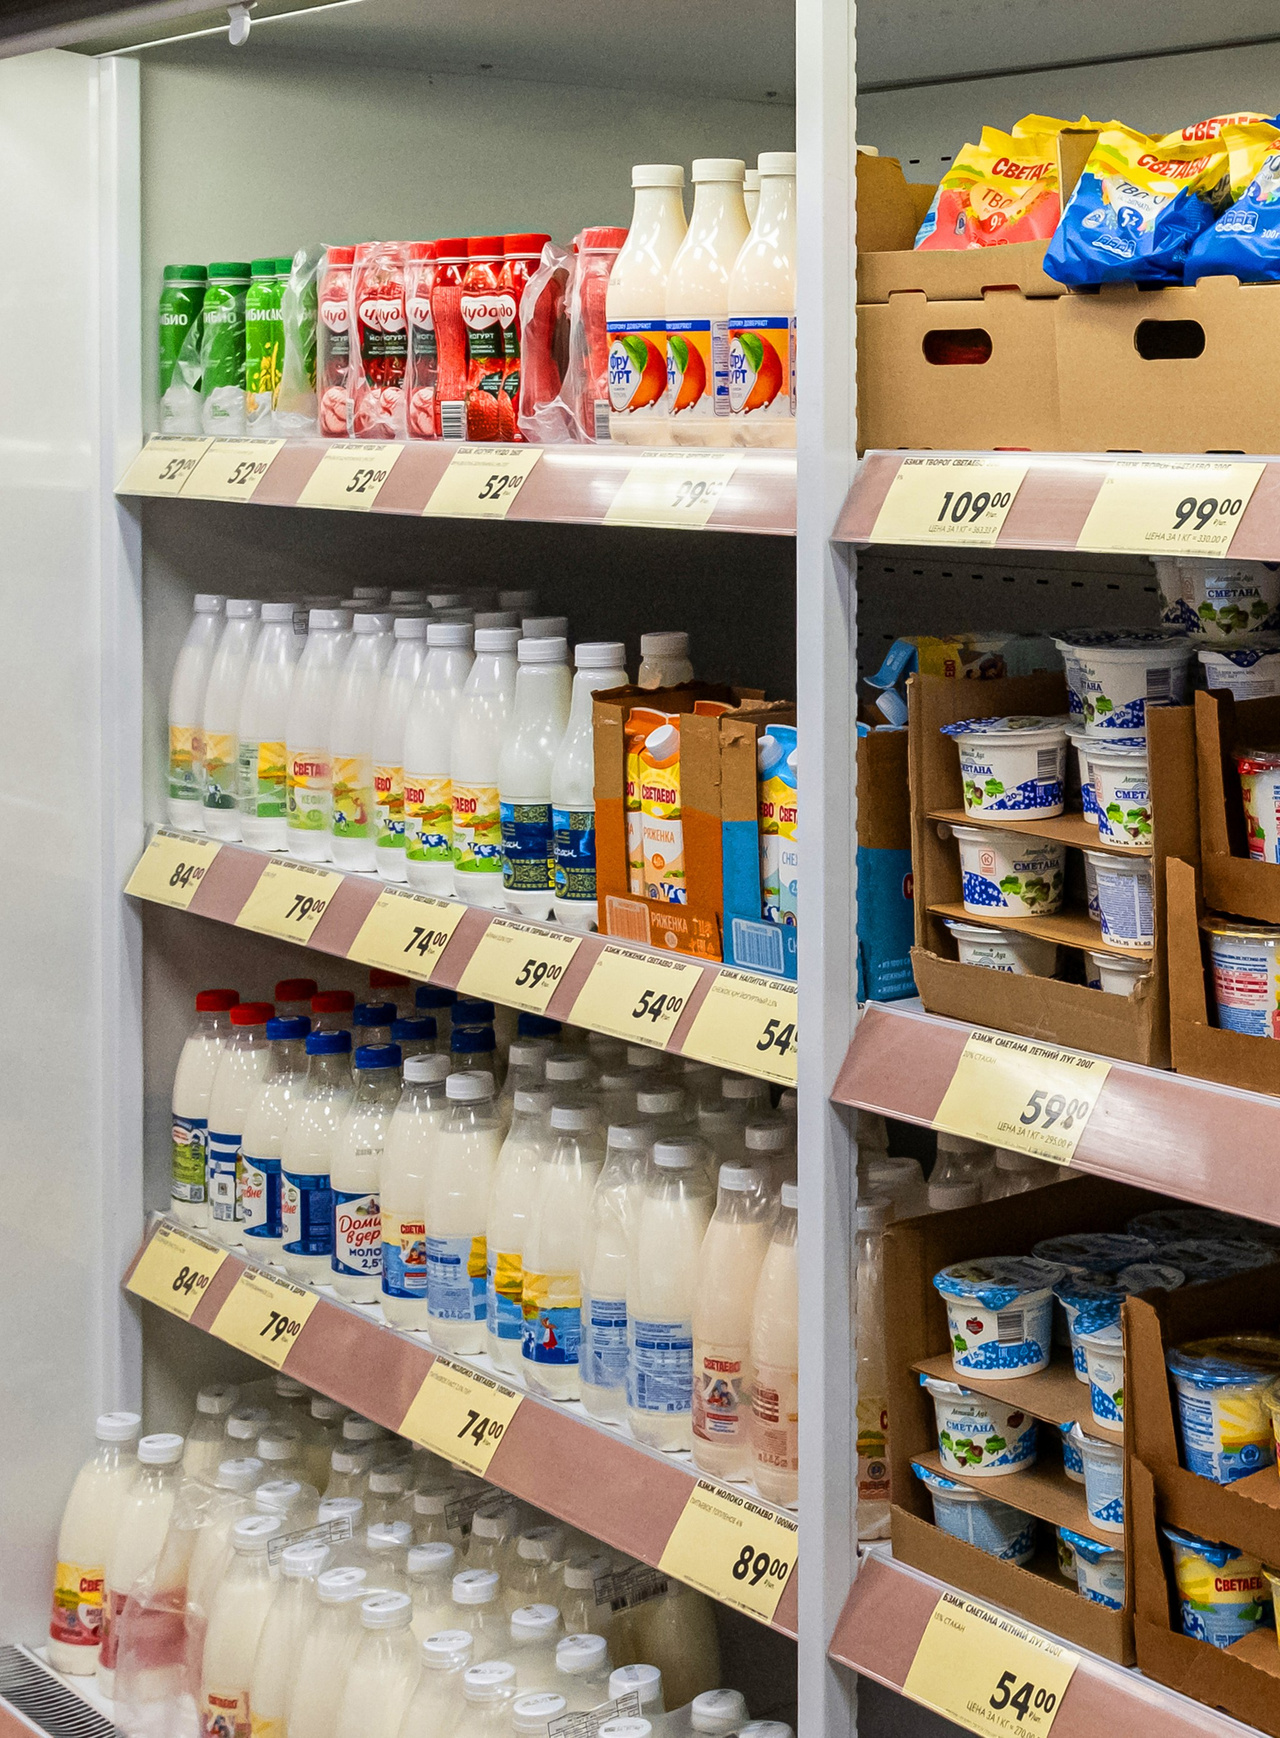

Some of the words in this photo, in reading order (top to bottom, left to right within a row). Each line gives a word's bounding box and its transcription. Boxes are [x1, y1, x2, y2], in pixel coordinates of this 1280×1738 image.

[929, 525, 946, 533] ЦЕНА
[1145, 532, 1165, 541] ЦЕНА
[1166, 533, 1176, 541] ЗА
[1207, 588, 1260, 598] СМЕТАНА
[641, 785, 677, 804] СВЕТАЕВО
[779, 806, 797, 822] СВЕТ
[643, 827, 675, 844] РЯЖЕНКА
[1014, 860, 1060, 872] СМЕТАНА
[651, 912, 688, 933] РЯЖЕНКА
[971, 1032, 994, 1044] БЗМЖ
[995, 1038, 1028, 1053] СМЕТАНА
[1029, 1046, 1060, 1060] ЛЕТНИЙ
[1059, 1053, 1075, 1064] ЛУГ
[997, 1121, 1016, 1133] ЦЕНА
[1016, 1126, 1027, 1136] ЗА
[1030, 1130, 1041, 1140] КГ
[355, 1229, 381, 1246] дер
[946, 1420, 995, 1433] СМЕТАНА
[715, 1487, 744, 1507] МОЛОКО
[743, 1501, 774, 1520] СВЕТАЕВО
[943, 1592, 965, 1610] БЗМЖ
[965, 1604, 998, 1627] СМЕТАНА
[998, 1618, 1030, 1641] ЛЕТНИЙ
[1028, 1633, 1044, 1649] ЛУГ
[943, 1616, 966, 1633] СТАКАН
[966, 1700, 986, 1717] ЦЕНА
[985, 1710, 997, 1723] ЗА
[999, 1716, 1010, 1729] КГ
